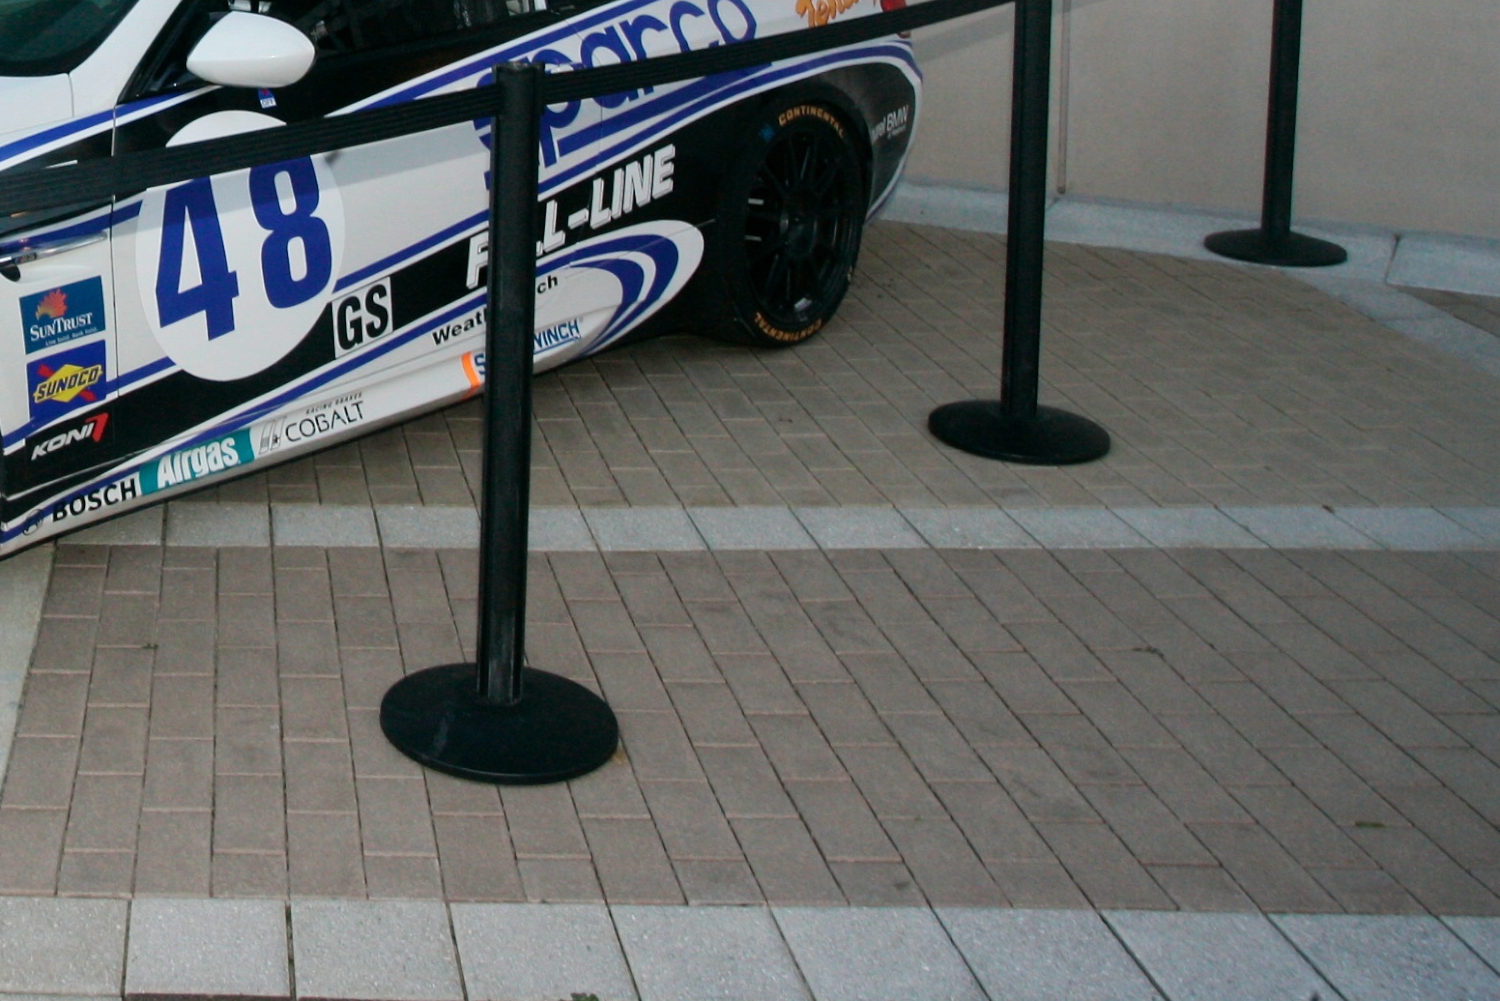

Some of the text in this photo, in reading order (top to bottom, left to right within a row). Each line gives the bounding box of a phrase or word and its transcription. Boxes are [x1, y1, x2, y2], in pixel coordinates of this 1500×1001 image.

[778, 104, 844, 139] CONTINENTAL
[886, 104, 909, 132] BMW
[466, 143, 676, 290] FL-LINE
[156, 154, 332, 341] 48
[336, 283, 389, 351] GS
[35, 364, 103, 403] SUNOCO
[31, 421, 95, 461] KONI
[285, 401, 364, 442] COBALT
[157, 436, 239, 489] Airgas
[52, 478, 137, 523] BOSCH
